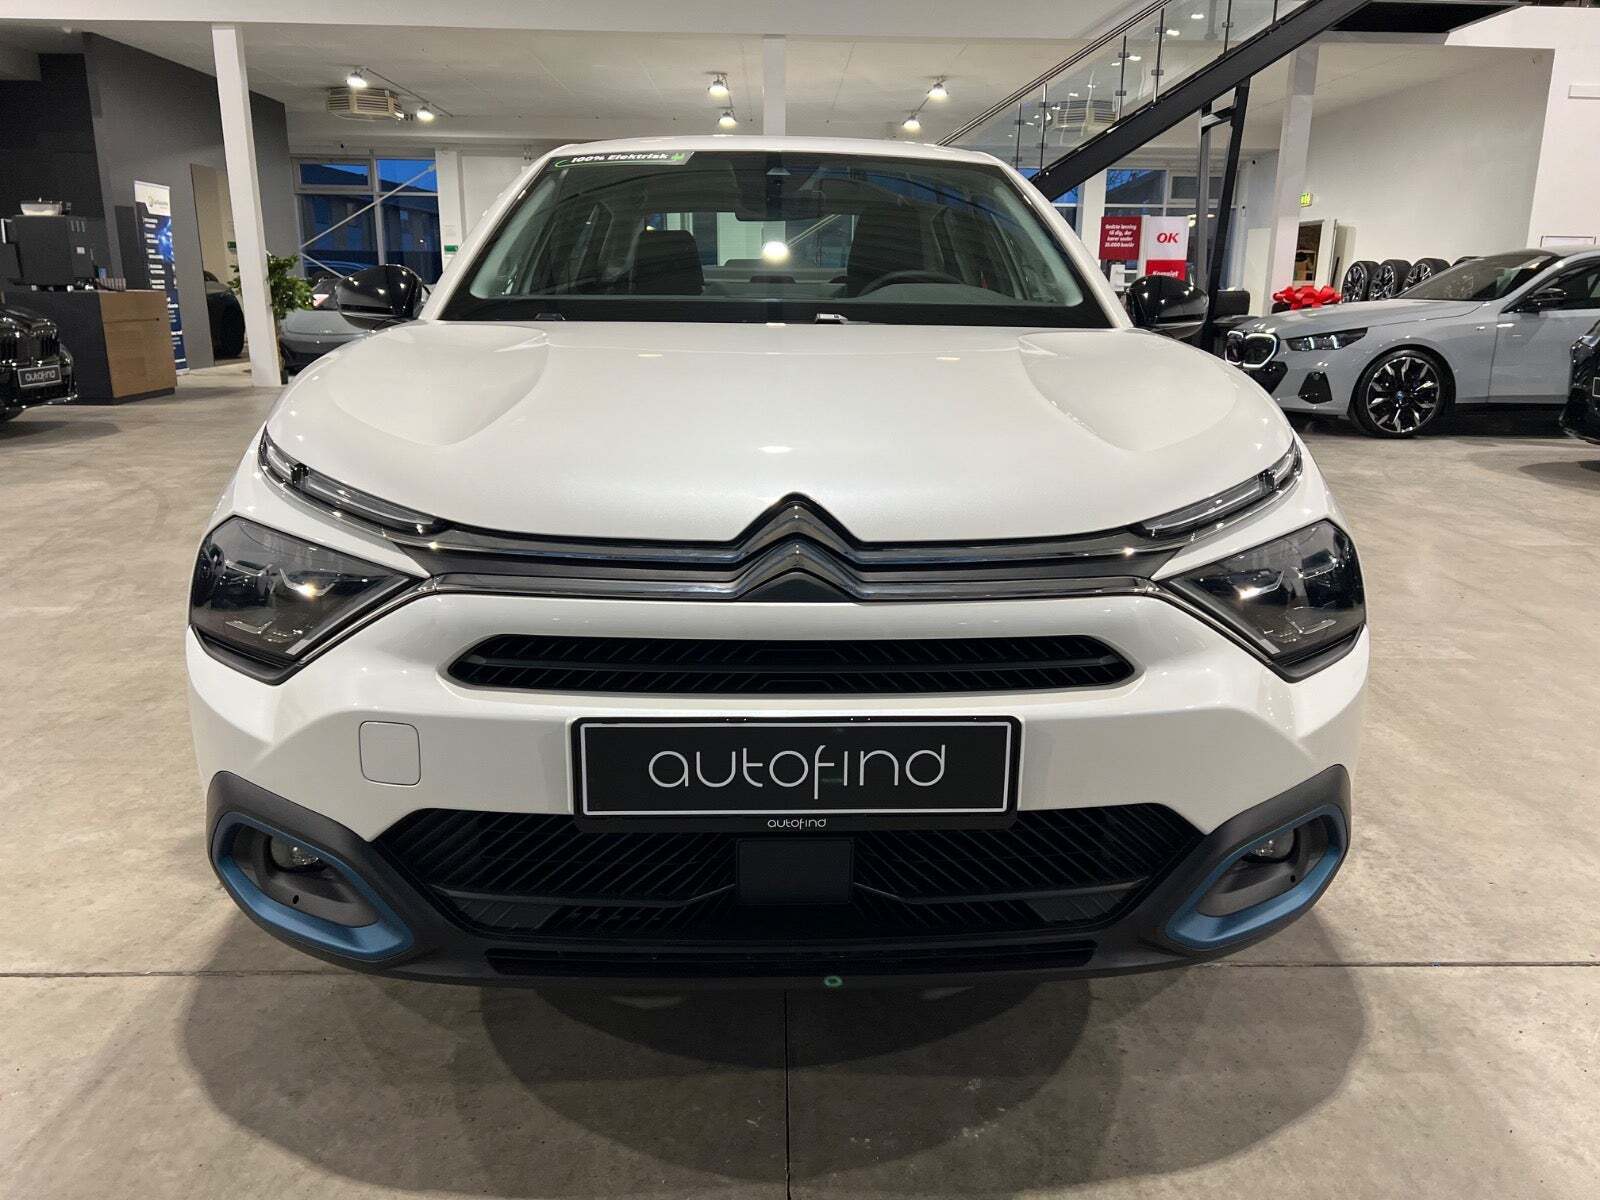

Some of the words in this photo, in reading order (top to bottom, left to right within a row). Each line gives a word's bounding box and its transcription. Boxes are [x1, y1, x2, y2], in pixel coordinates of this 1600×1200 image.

[571, 155, 605, 163] 100%
[607, 153, 669, 161] Elektrisk
[1157, 232, 1179, 243] OK
[648, 744, 946, 800] autofind
[767, 818, 827, 830] autofind
